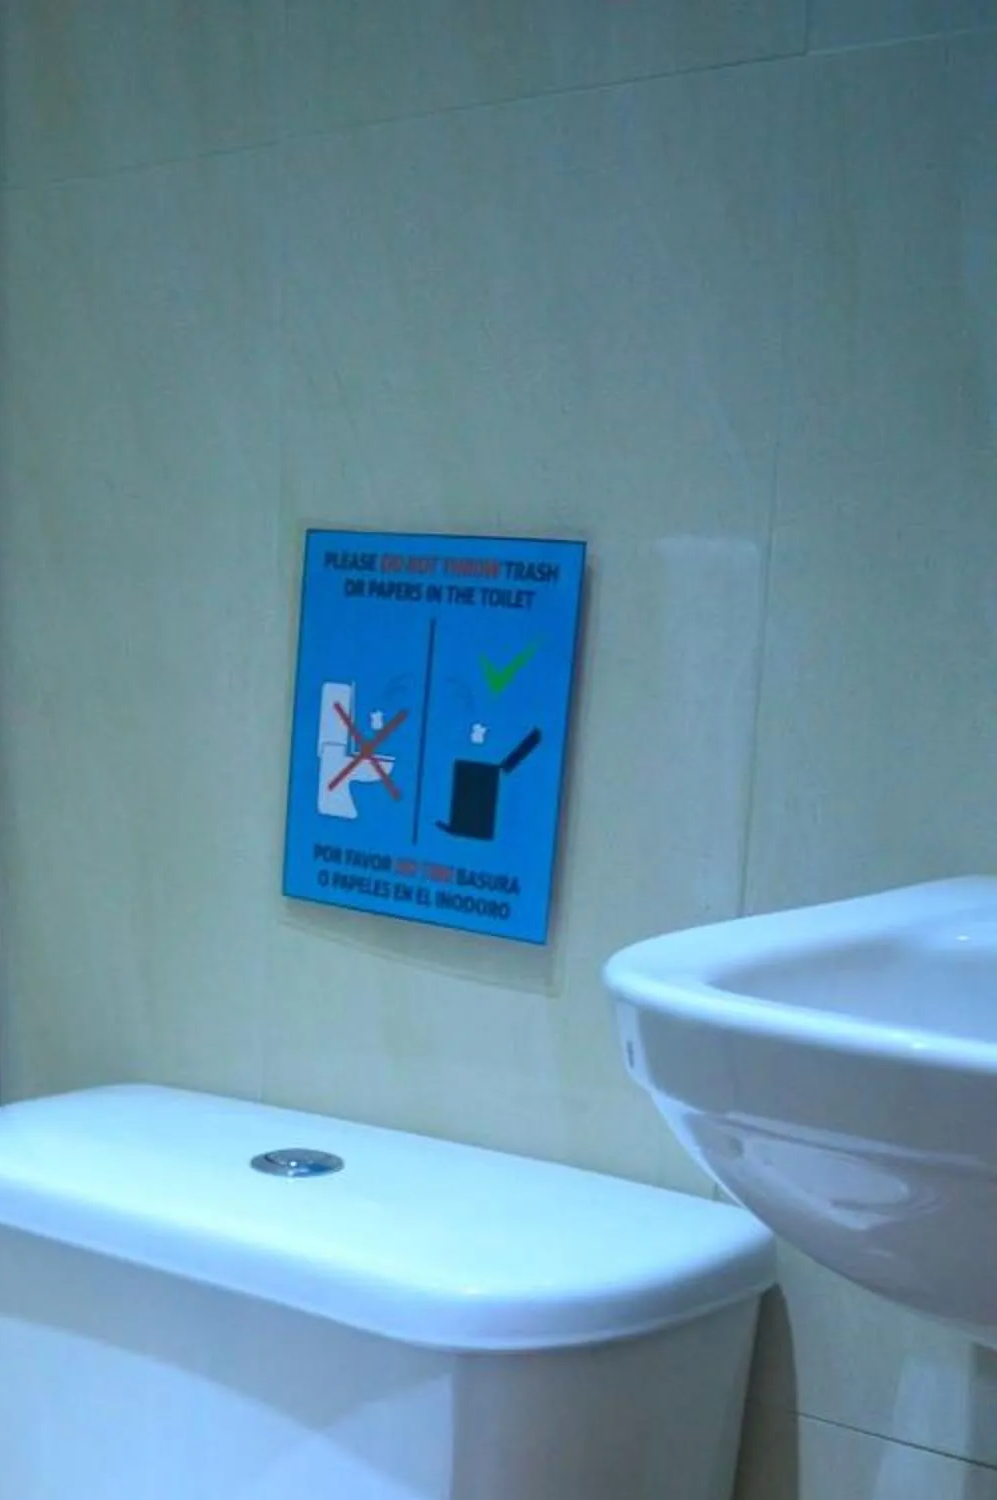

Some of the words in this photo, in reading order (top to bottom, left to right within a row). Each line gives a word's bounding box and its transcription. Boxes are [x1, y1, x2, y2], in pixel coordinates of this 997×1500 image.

[324, 551, 379, 572] PLEASE
[506, 559, 559, 583] TRASH
[344, 577, 365, 598] OR
[368, 579, 422, 602] PAPERS
[426, 585, 442, 604] IN
[446, 586, 476, 607] THE
[481, 588, 537, 610] TOILET
[314, 844, 343, 865] POR
[345, 848, 393, 873] FAVOR
[456, 868, 521, 897] BASURA
[332, 872, 391, 899] PAPELES
[393, 885, 413, 902] EN
[415, 887, 431, 907] EL
[435, 890, 511, 920] INODORO
